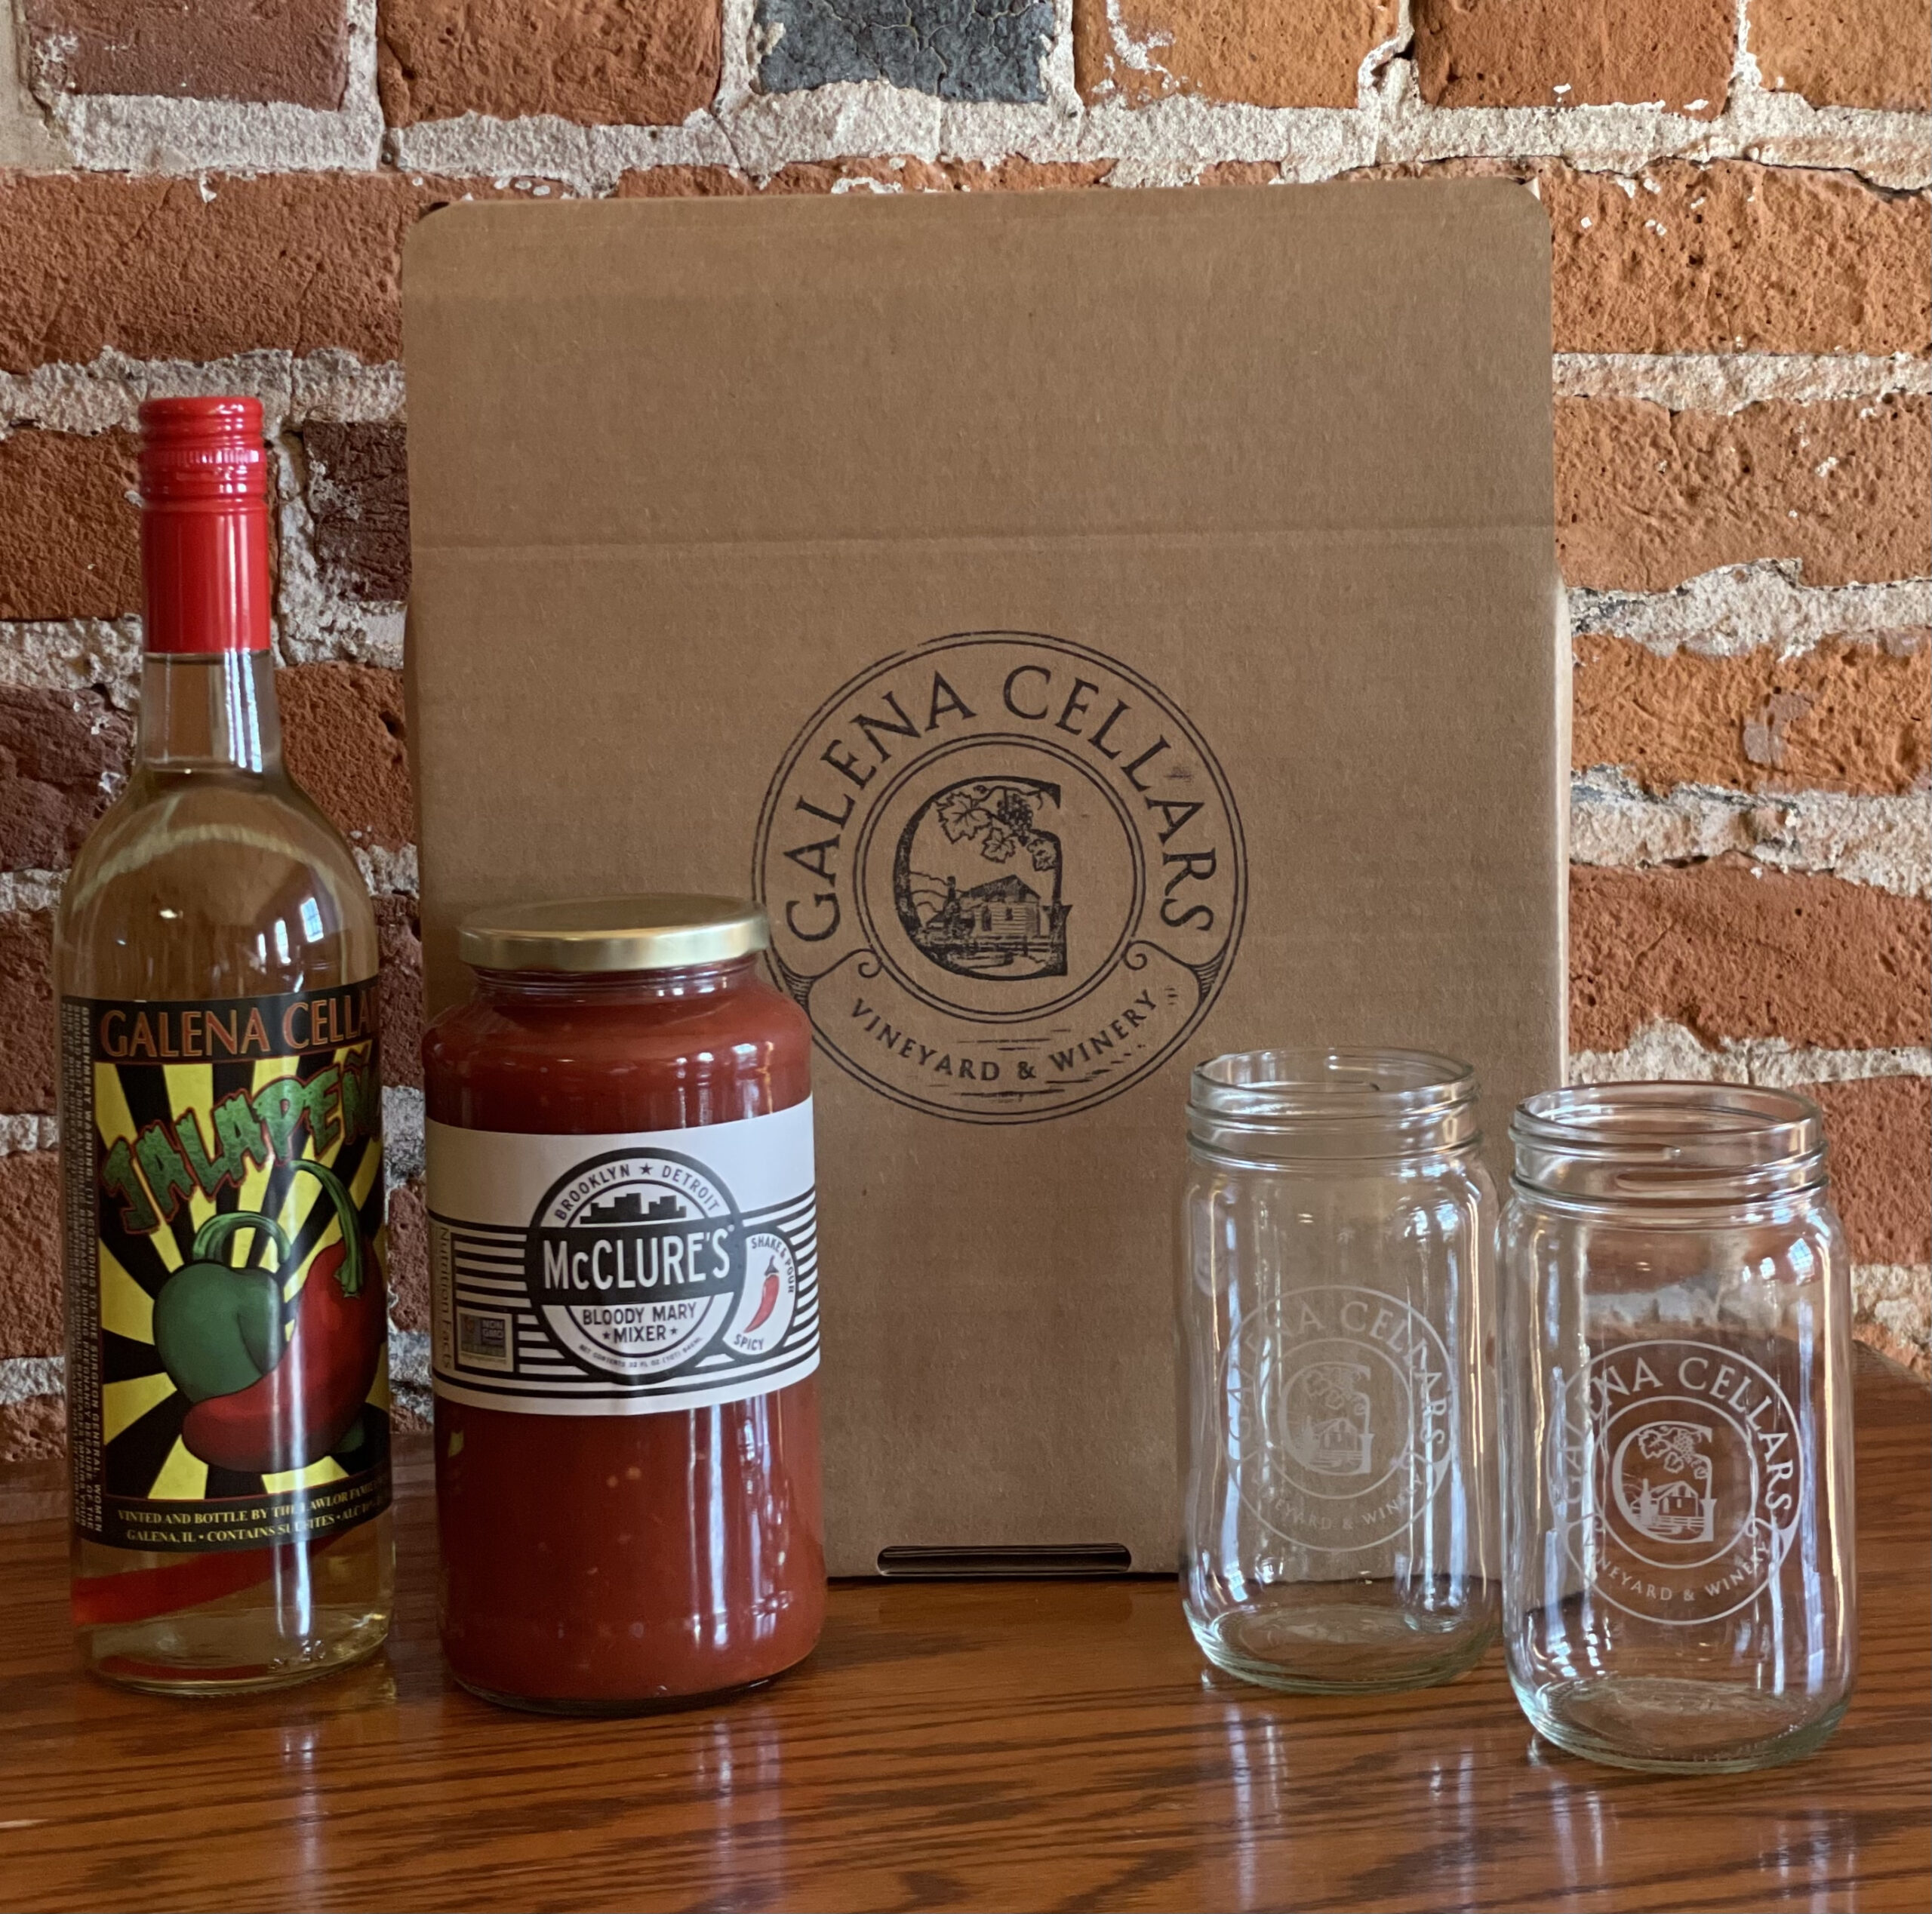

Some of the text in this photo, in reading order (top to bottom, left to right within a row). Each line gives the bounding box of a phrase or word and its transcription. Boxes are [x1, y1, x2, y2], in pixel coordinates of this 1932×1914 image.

[783, 664, 1217, 943] GALENA CELLARS
[100, 1008, 271, 1057] GALENA
[851, 988, 1159, 1082] VINEYARD & WINERY
[554, 1164, 721, 1220] BROOKLYN DETROIT
[751, 1236, 782, 1254] SHAKE
[785, 1259, 795, 1294] POUR
[583, 1301, 697, 1325] BLOODY MARY
[614, 1325, 666, 1343] MIXER
[734, 1334, 764, 1351] SPICY
[1678, 1357, 1793, 1514] CELLARS
[118, 1510, 162, 1524] VINTED
[165, 1512, 191, 1525] AND
[194, 1511, 248, 1524] BOTTLE
[251, 1509, 267, 1521] BY
[272, 1504, 298, 1518] TH
[183, 1531, 196, 1543] IL
[208, 1525, 275, 1542] CONTAINS
[1682, 1588, 1696, 1602] &
[1704, 1541, 1770, 1597] WINERY
